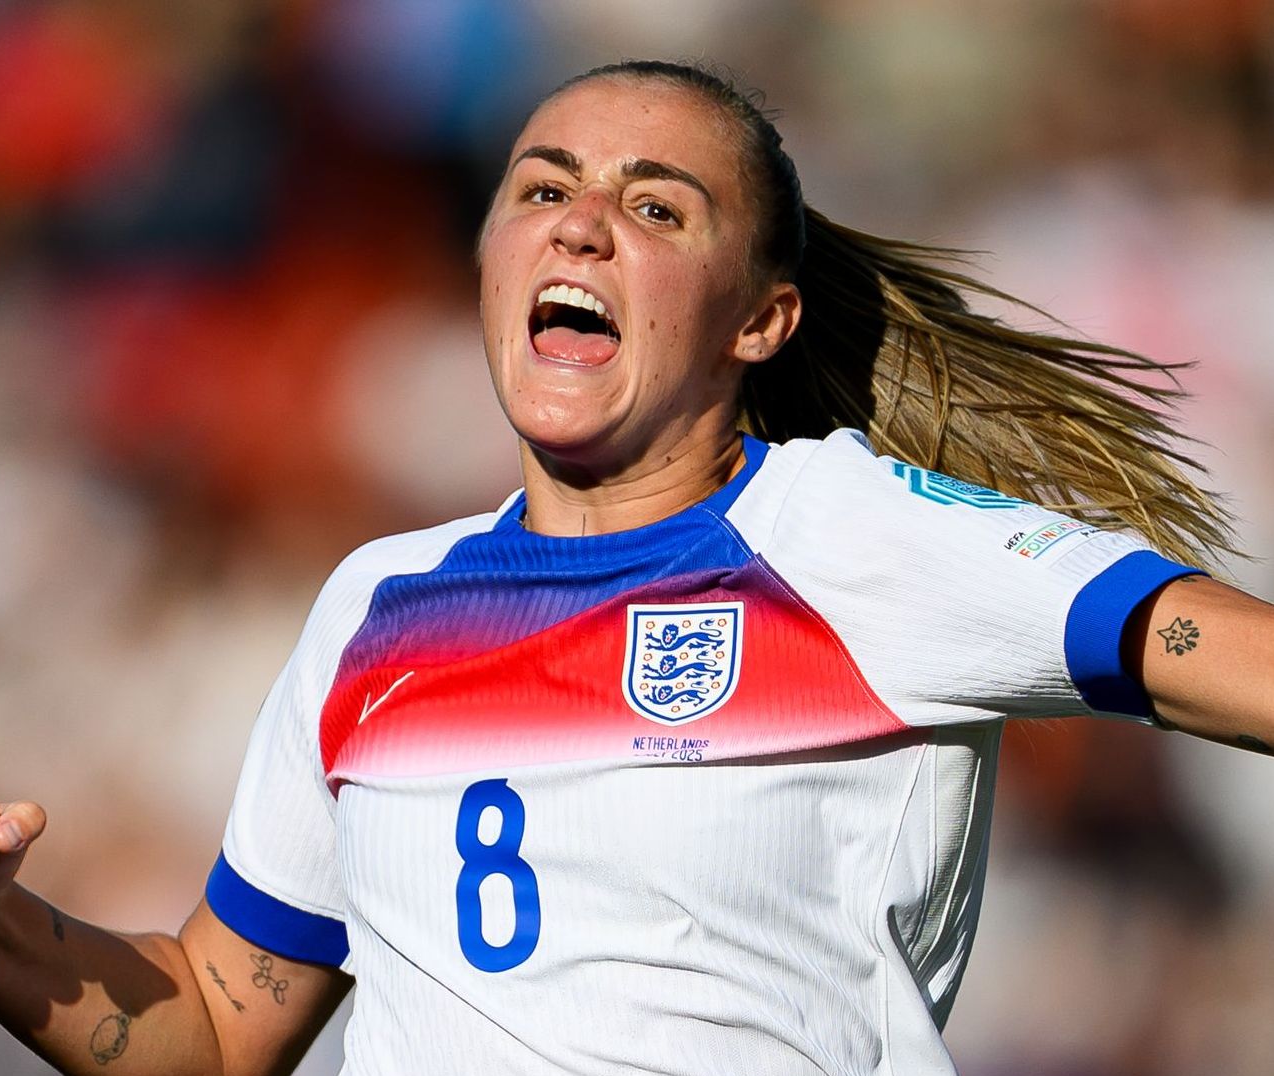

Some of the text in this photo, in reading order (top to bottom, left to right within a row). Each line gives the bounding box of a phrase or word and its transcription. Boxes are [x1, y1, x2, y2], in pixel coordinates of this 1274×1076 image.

[1004, 531, 1026, 550] UEFA
[633, 736, 710, 750] NETHERLANDS
[671, 749, 703, 762] 2025
[456, 777, 541, 973] 8
